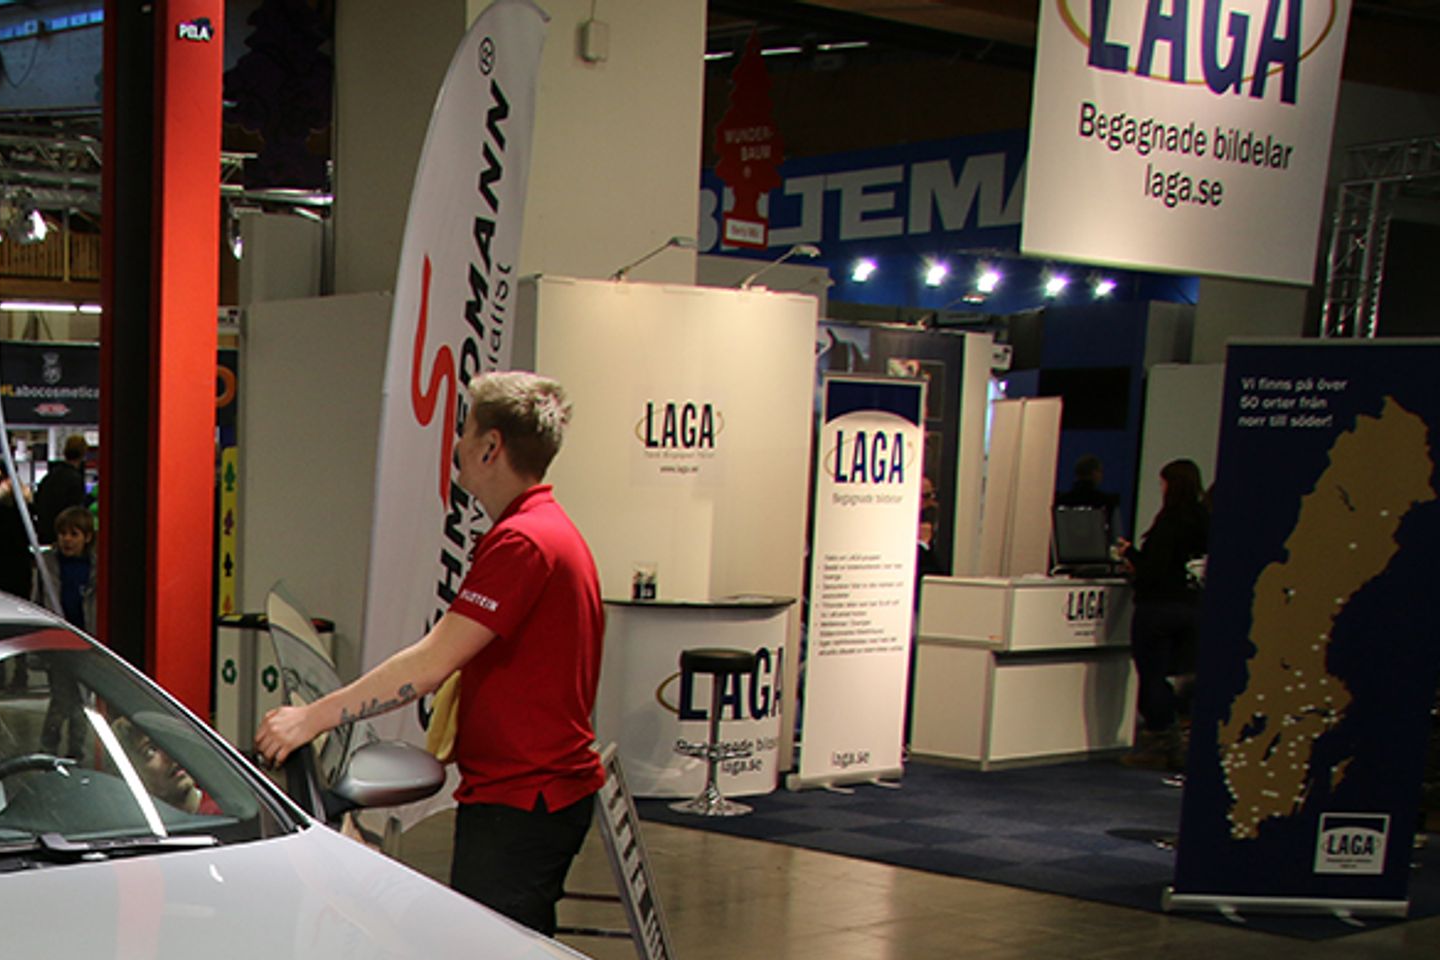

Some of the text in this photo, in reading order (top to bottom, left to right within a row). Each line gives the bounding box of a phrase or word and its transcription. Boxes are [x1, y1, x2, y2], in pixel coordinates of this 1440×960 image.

[1087, 0, 1304, 106] LAGA
[1079, 101, 1295, 170] Begagnade bildelar
[1143, 163, 1224, 209] laga.se
[645, 402, 715, 448] LAGA
[834, 430, 904, 484] LAGA
[1067, 590, 1106, 620] LAGA
[1326, 834, 1375, 856] LAGA
